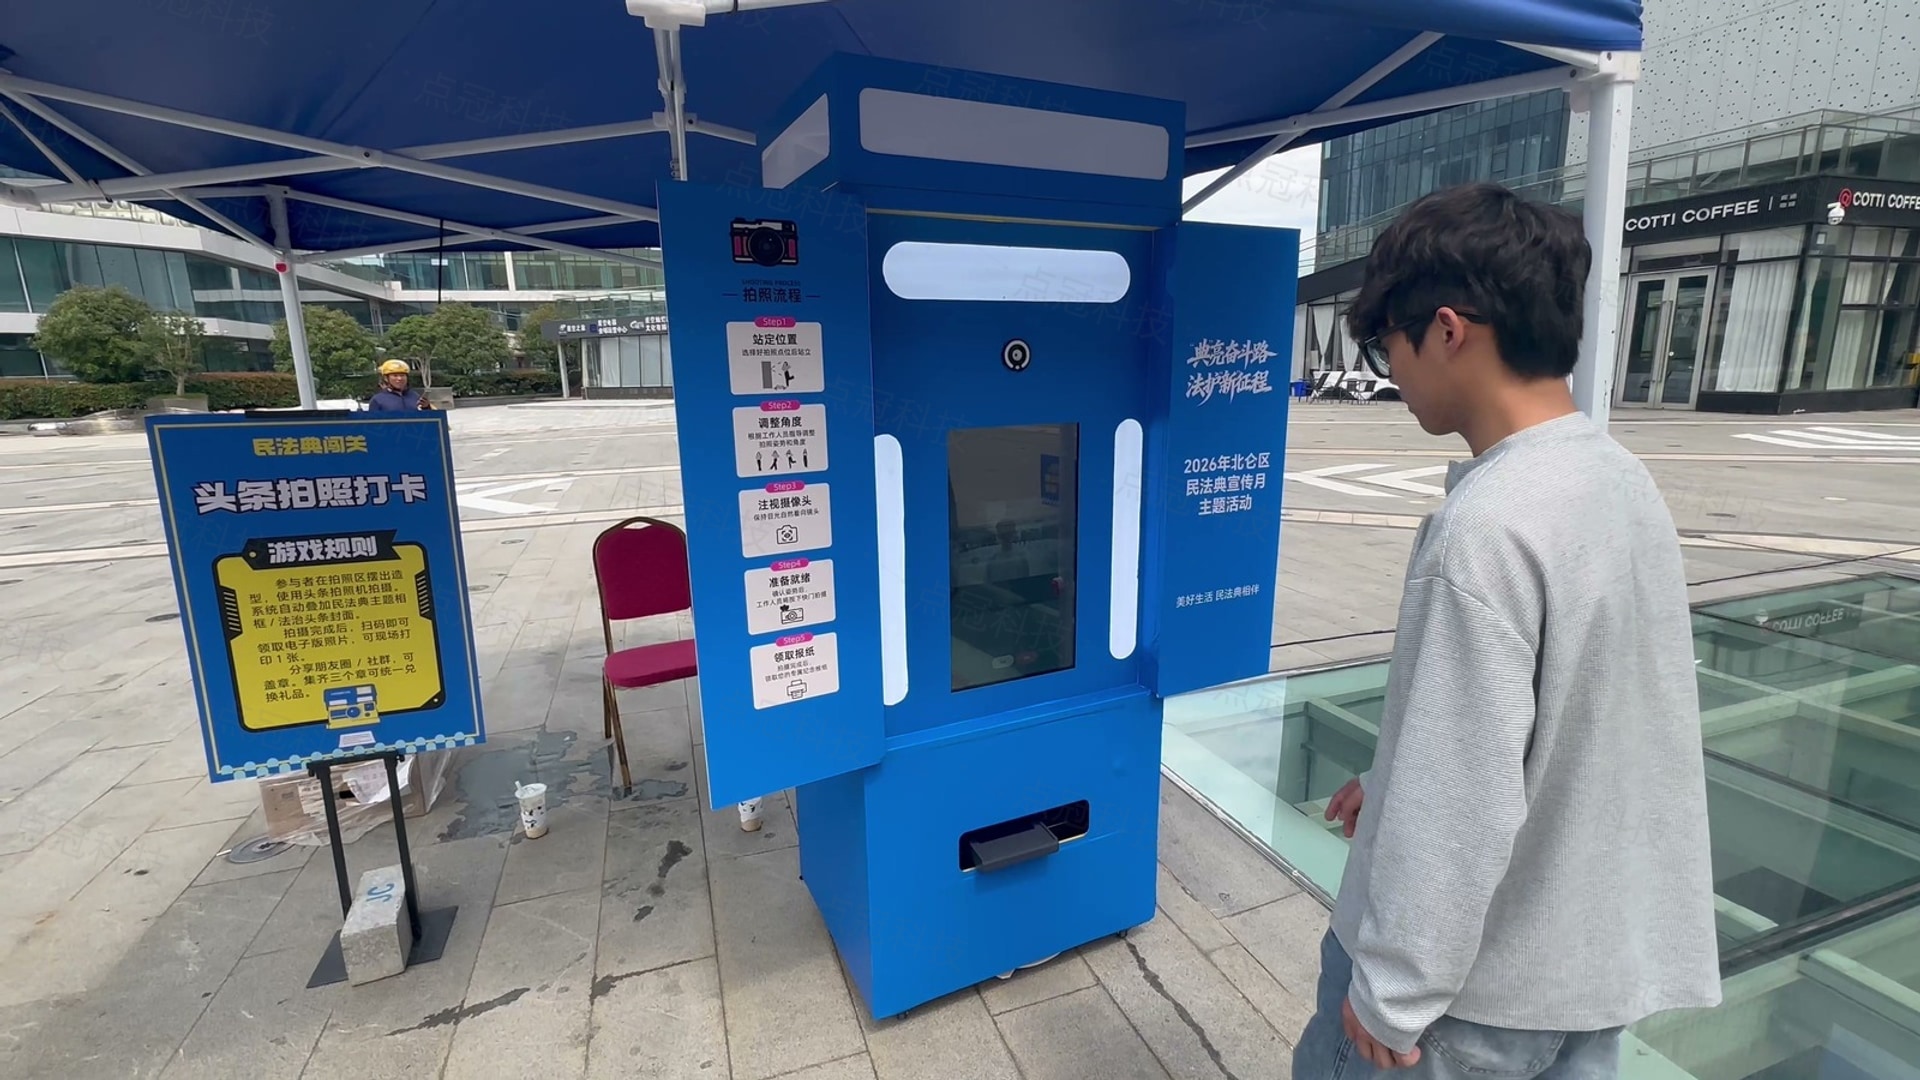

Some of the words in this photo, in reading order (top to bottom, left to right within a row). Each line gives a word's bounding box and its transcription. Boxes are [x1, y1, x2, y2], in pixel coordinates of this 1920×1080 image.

[1853, 192, 1886, 208] COTTI
[1625, 213, 1676, 232] COTTI
[1682, 199, 1760, 224] COFFEE
[742, 287, 802, 303] 拍照流程
[763, 317, 786, 327] Step1
[753, 334, 798, 346] 站定位置
[768, 402, 792, 411] Step2
[758, 416, 802, 428] 调整角度
[252, 434, 368, 458] 民法典闯关
[1184, 452, 1271, 474] 2026年北仑区
[774, 482, 796, 491] Step3
[1186, 473, 1266, 496] 民法典宣传月
[194, 474, 427, 515] 头条拍照打卡
[758, 495, 812, 511] 注视摄像头
[1198, 494, 1252, 516] 主题活动
[268, 536, 378, 564] 游戏规则
[778, 560, 801, 570] Step4
[276, 570, 404, 589] 参与者在拍照区摆出造
[769, 572, 810, 588] 准备就绪
[1176, 590, 1214, 608] 美好生活
[1216, 584, 1260, 601] 民法典相伴
[252, 594, 406, 616] 系统自动叠加民法典主题相
[784, 634, 805, 645] Step5
[774, 646, 815, 662] 领取报纸
